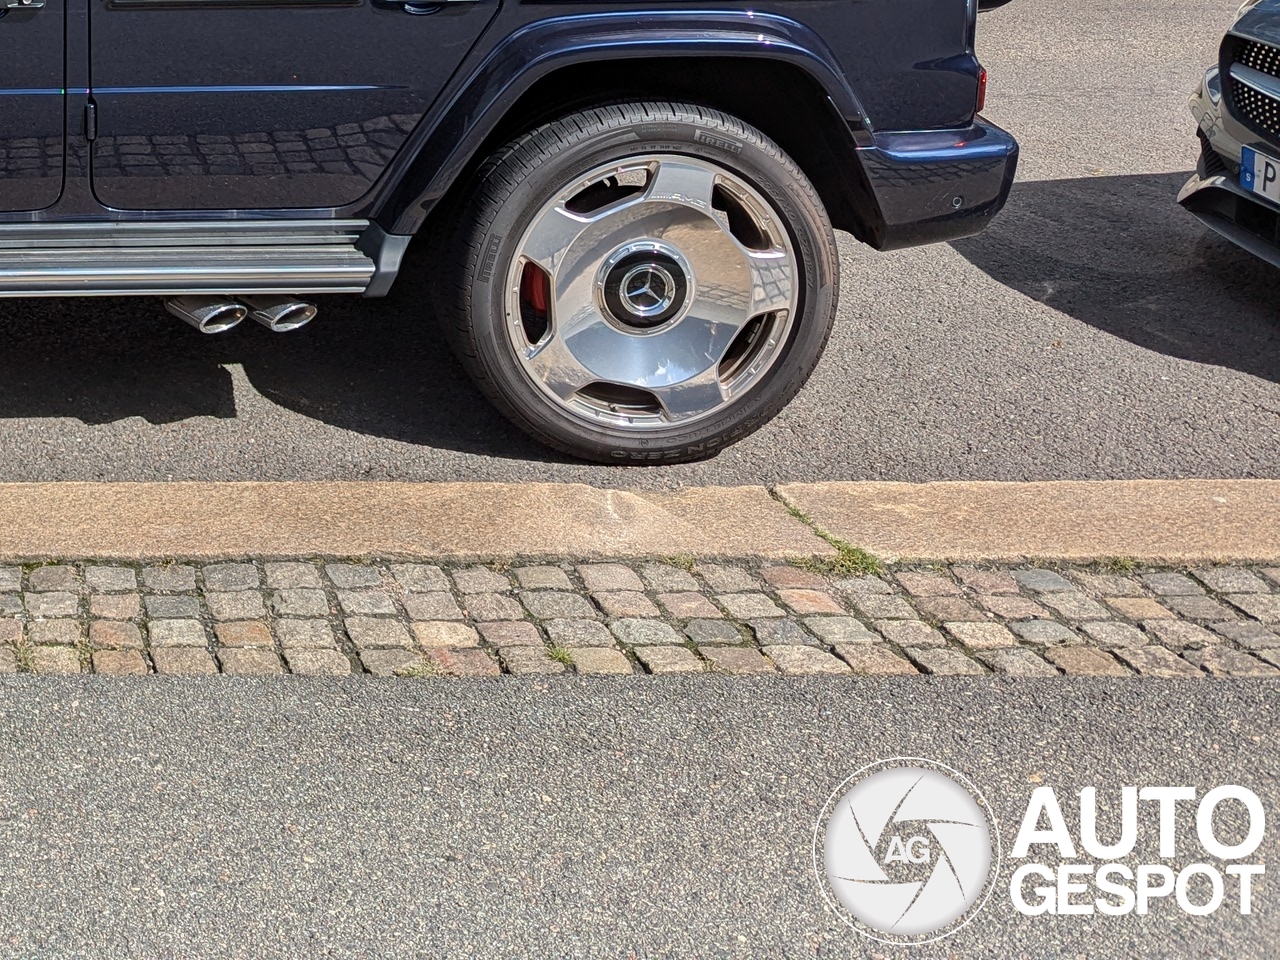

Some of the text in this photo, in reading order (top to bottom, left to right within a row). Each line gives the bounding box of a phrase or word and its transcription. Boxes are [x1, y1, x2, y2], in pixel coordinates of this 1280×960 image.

[1245, 160, 1277, 192] S P
[610, 448, 682, 461] ZERO
